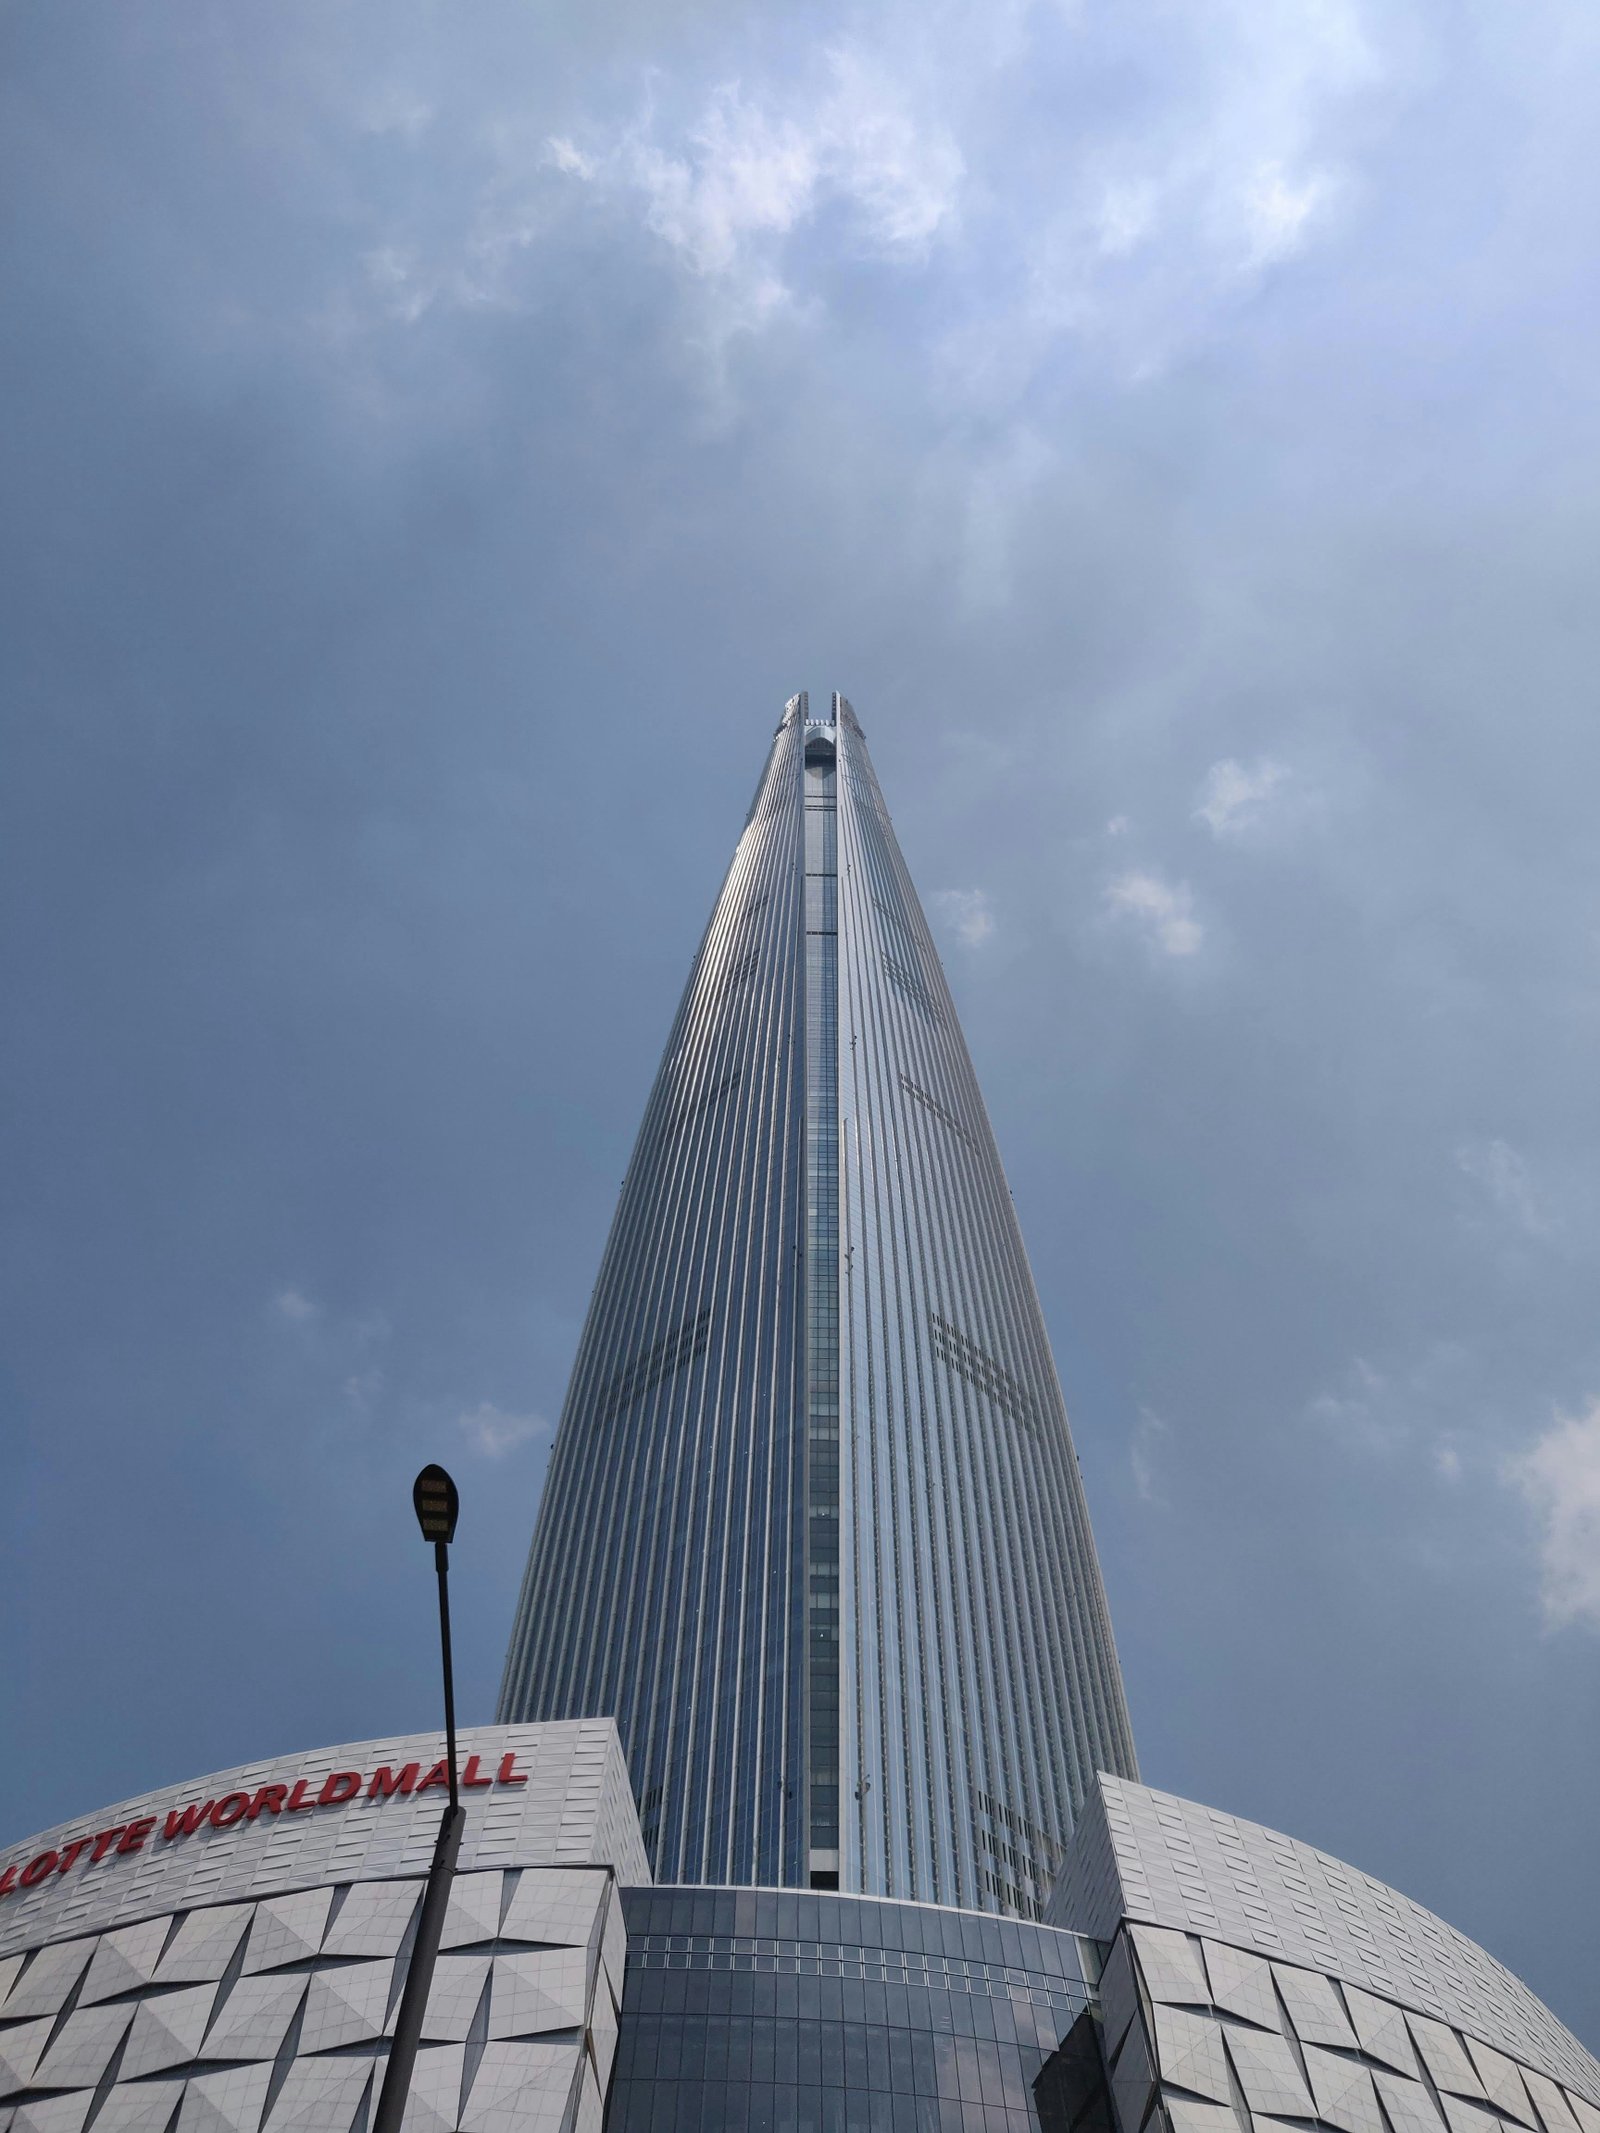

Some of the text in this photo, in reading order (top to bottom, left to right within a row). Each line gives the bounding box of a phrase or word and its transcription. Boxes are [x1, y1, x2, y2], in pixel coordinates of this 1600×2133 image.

[0, 1752, 528, 1895] LOTTE WORLD MALL
